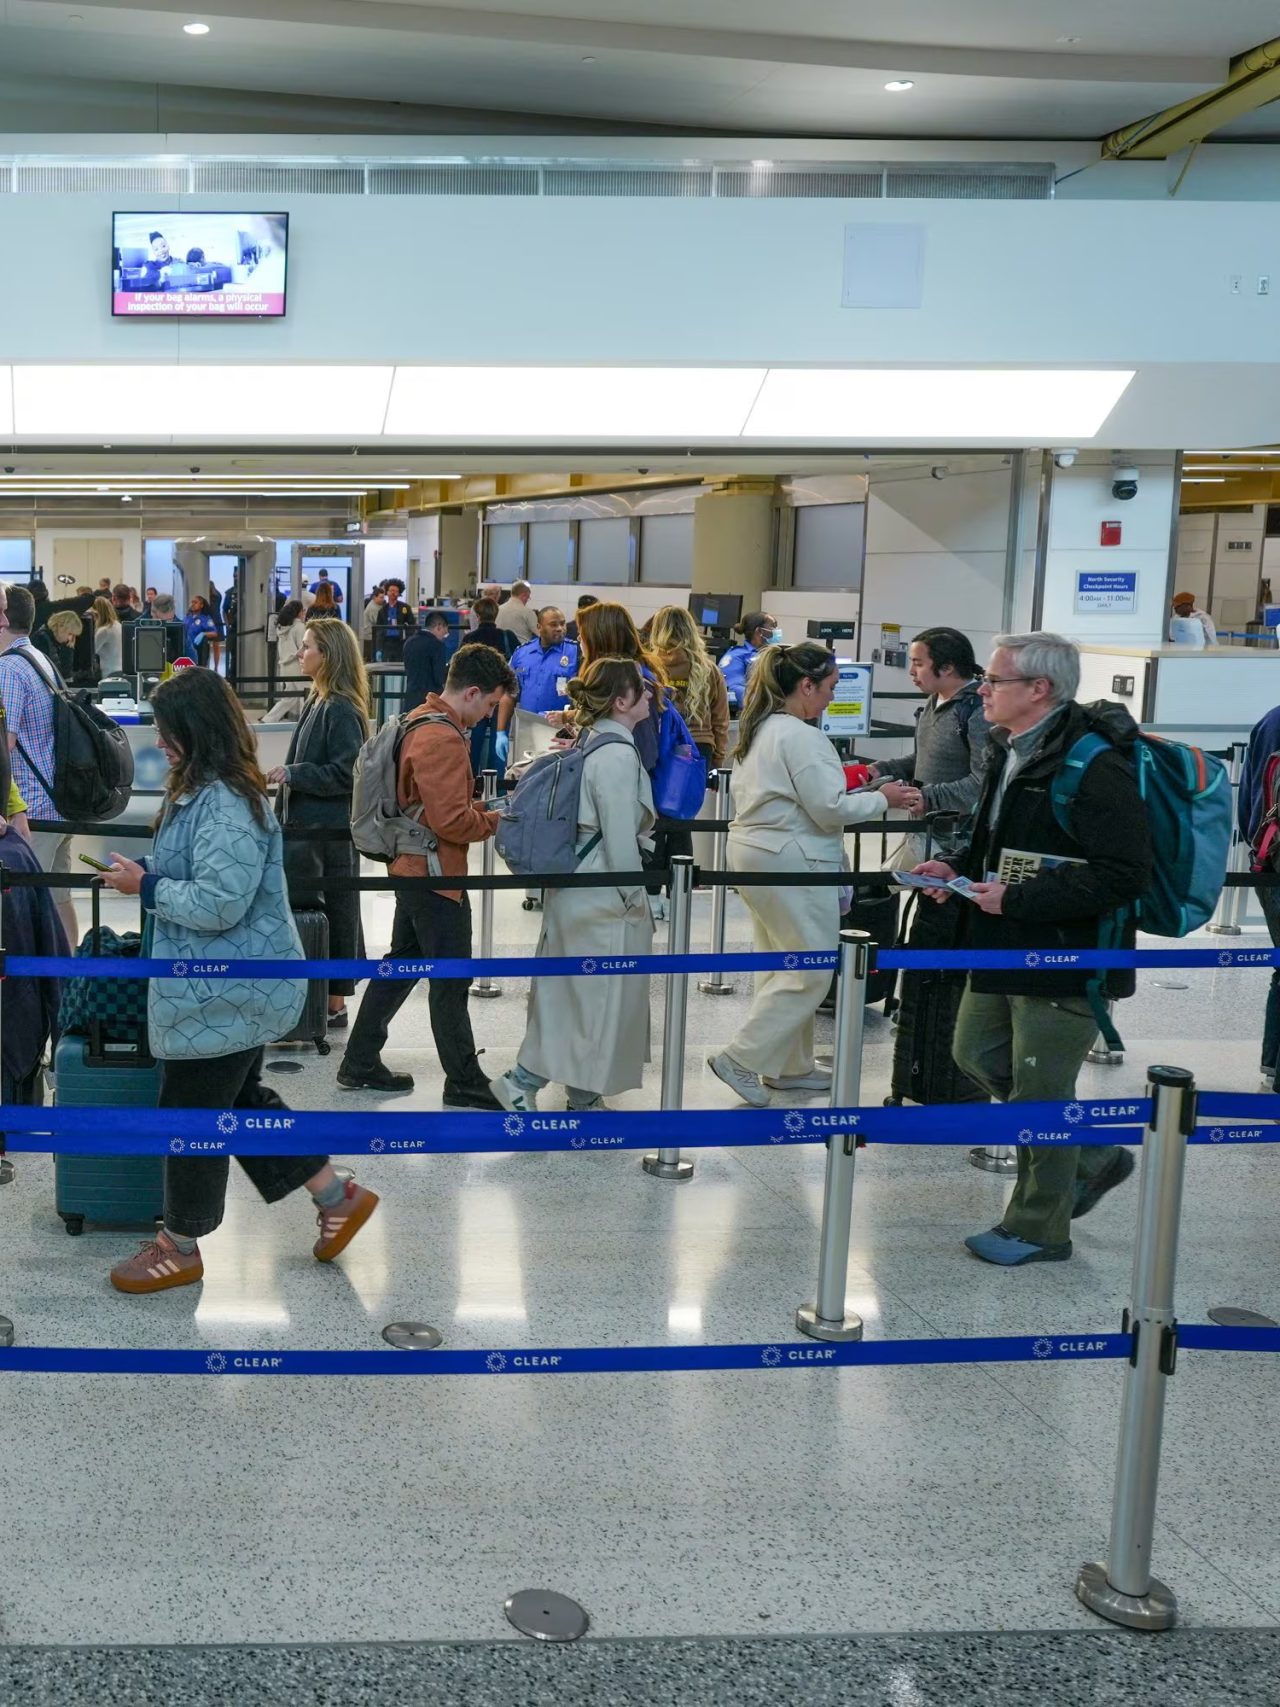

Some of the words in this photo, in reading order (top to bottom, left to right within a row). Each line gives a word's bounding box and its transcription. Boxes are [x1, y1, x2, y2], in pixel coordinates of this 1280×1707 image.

[144, 294, 165, 303] your
[166, 293, 184, 303] bag
[226, 293, 262, 303] physical
[174, 302, 184, 311] of
[186, 303, 207, 312] your
[208, 302, 225, 312] bag
[226, 302, 243, 311] will
[245, 303, 269, 311] occur
